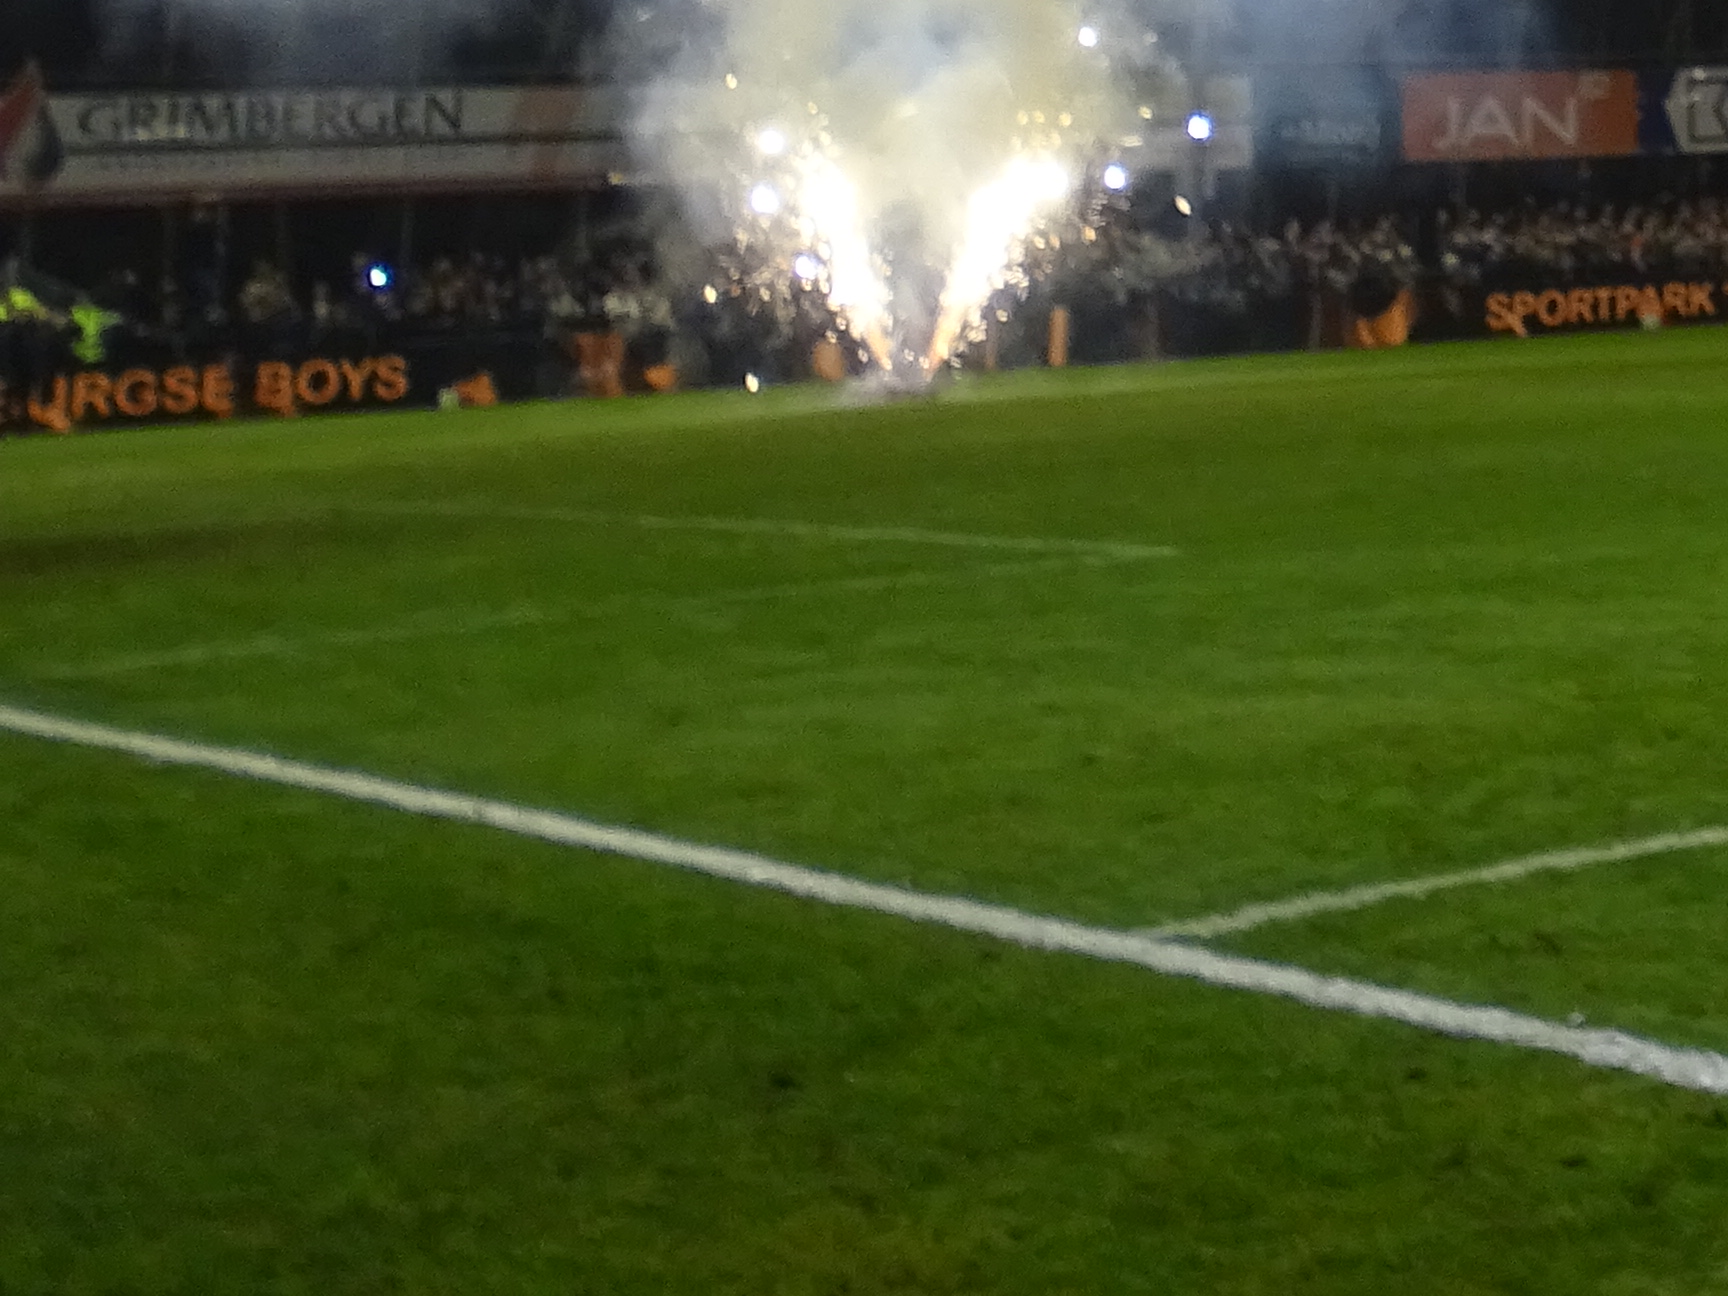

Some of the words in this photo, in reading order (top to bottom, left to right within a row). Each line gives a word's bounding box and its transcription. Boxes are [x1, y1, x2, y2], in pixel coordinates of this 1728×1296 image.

[77, 91, 463, 142] GRIMBERGEN
[1433, 96, 1580, 150] JAN
[1485, 281, 1715, 332] SPORTPARK
[254, 354, 408, 411] BOYS
